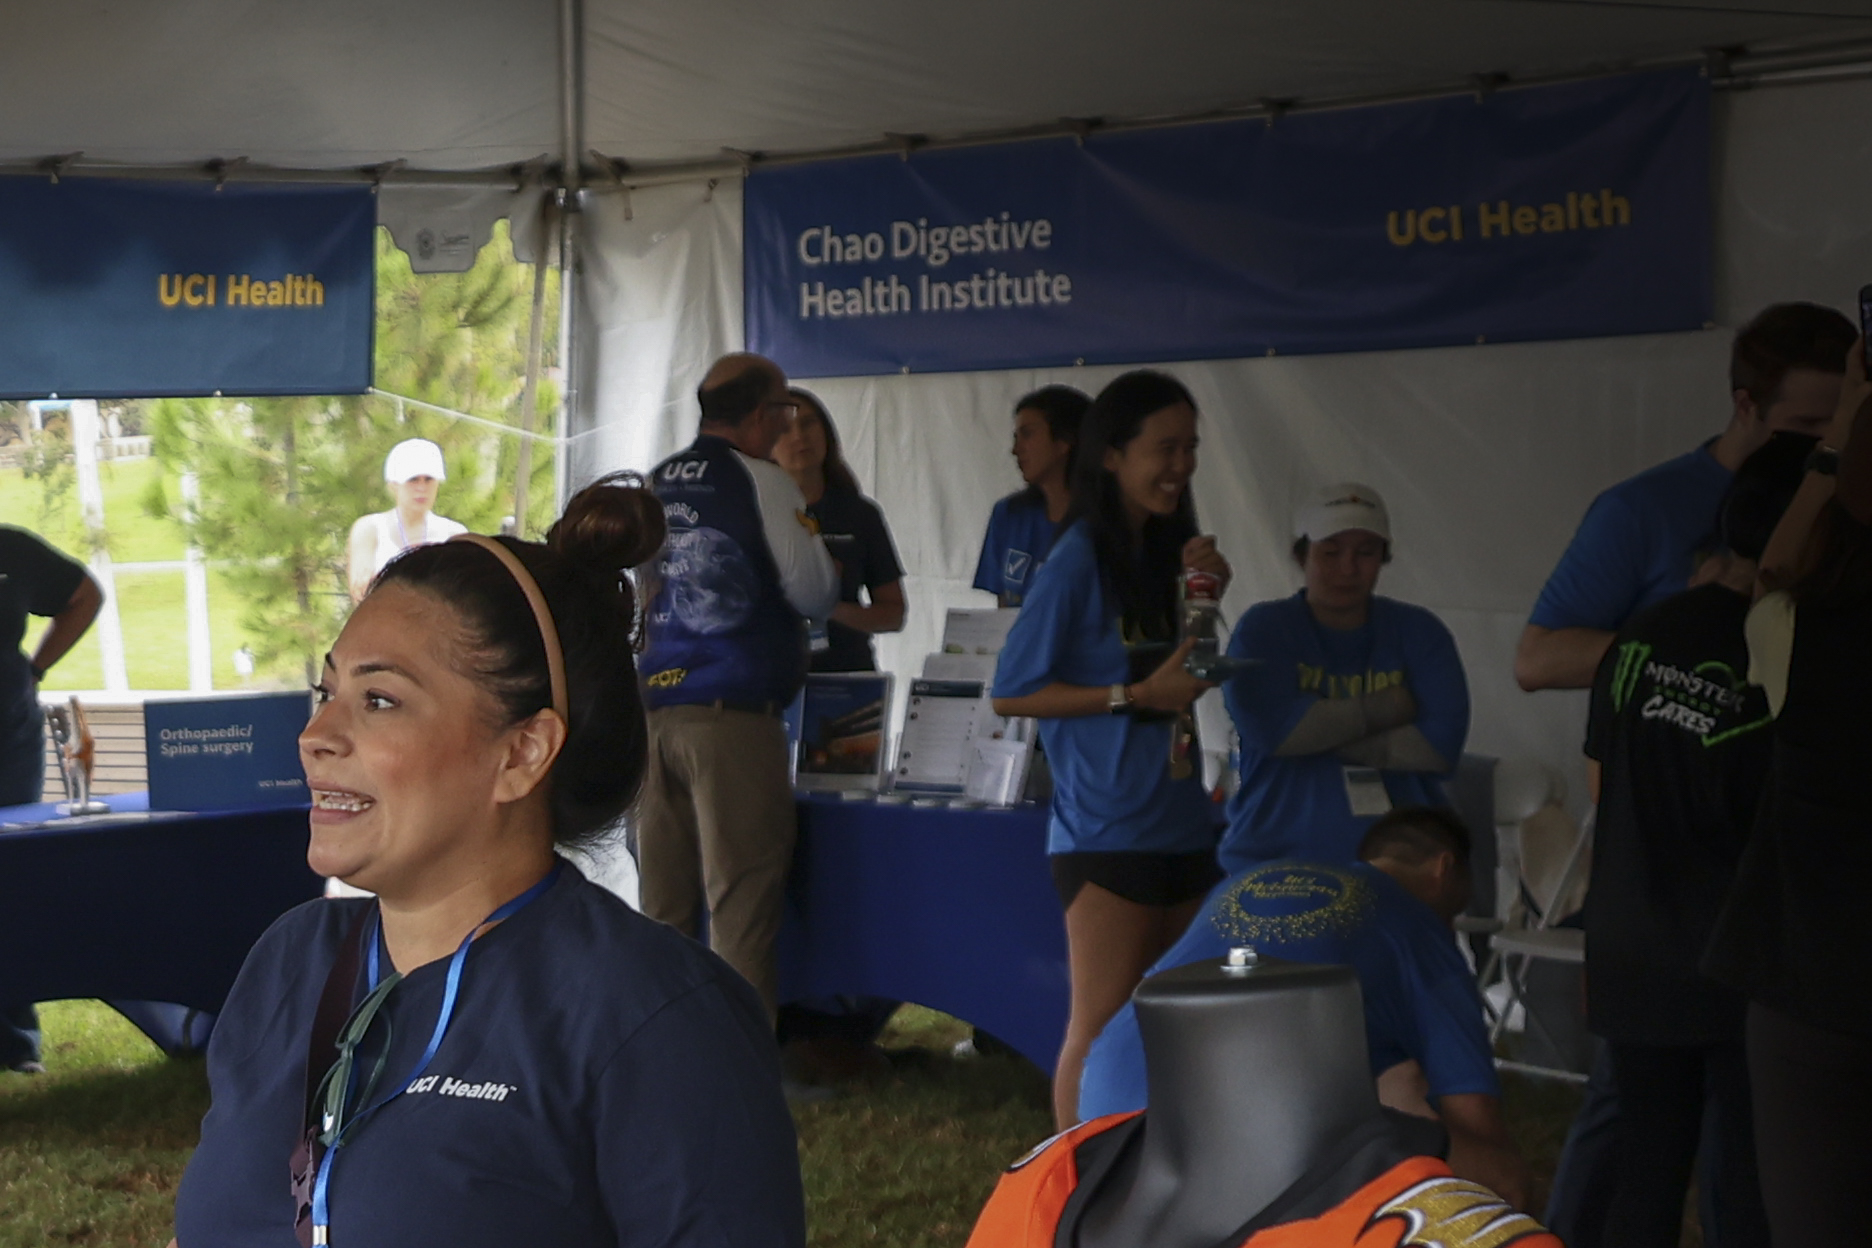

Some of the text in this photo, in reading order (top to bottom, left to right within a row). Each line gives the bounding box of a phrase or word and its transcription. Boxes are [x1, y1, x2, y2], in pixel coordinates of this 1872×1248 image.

[1387, 189, 1631, 248] UCI Health
[798, 211, 1053, 267] Chao Digestive
[158, 273, 325, 308] UCI Health
[800, 267, 1073, 318] Health Institute
[664, 460, 709, 481] UCI
[1640, 694, 1716, 735] CARES
[160, 724, 253, 742] Orthopaedic/
[161, 740, 254, 758] Spine surgery
[406, 1075, 440, 1094] UCI
